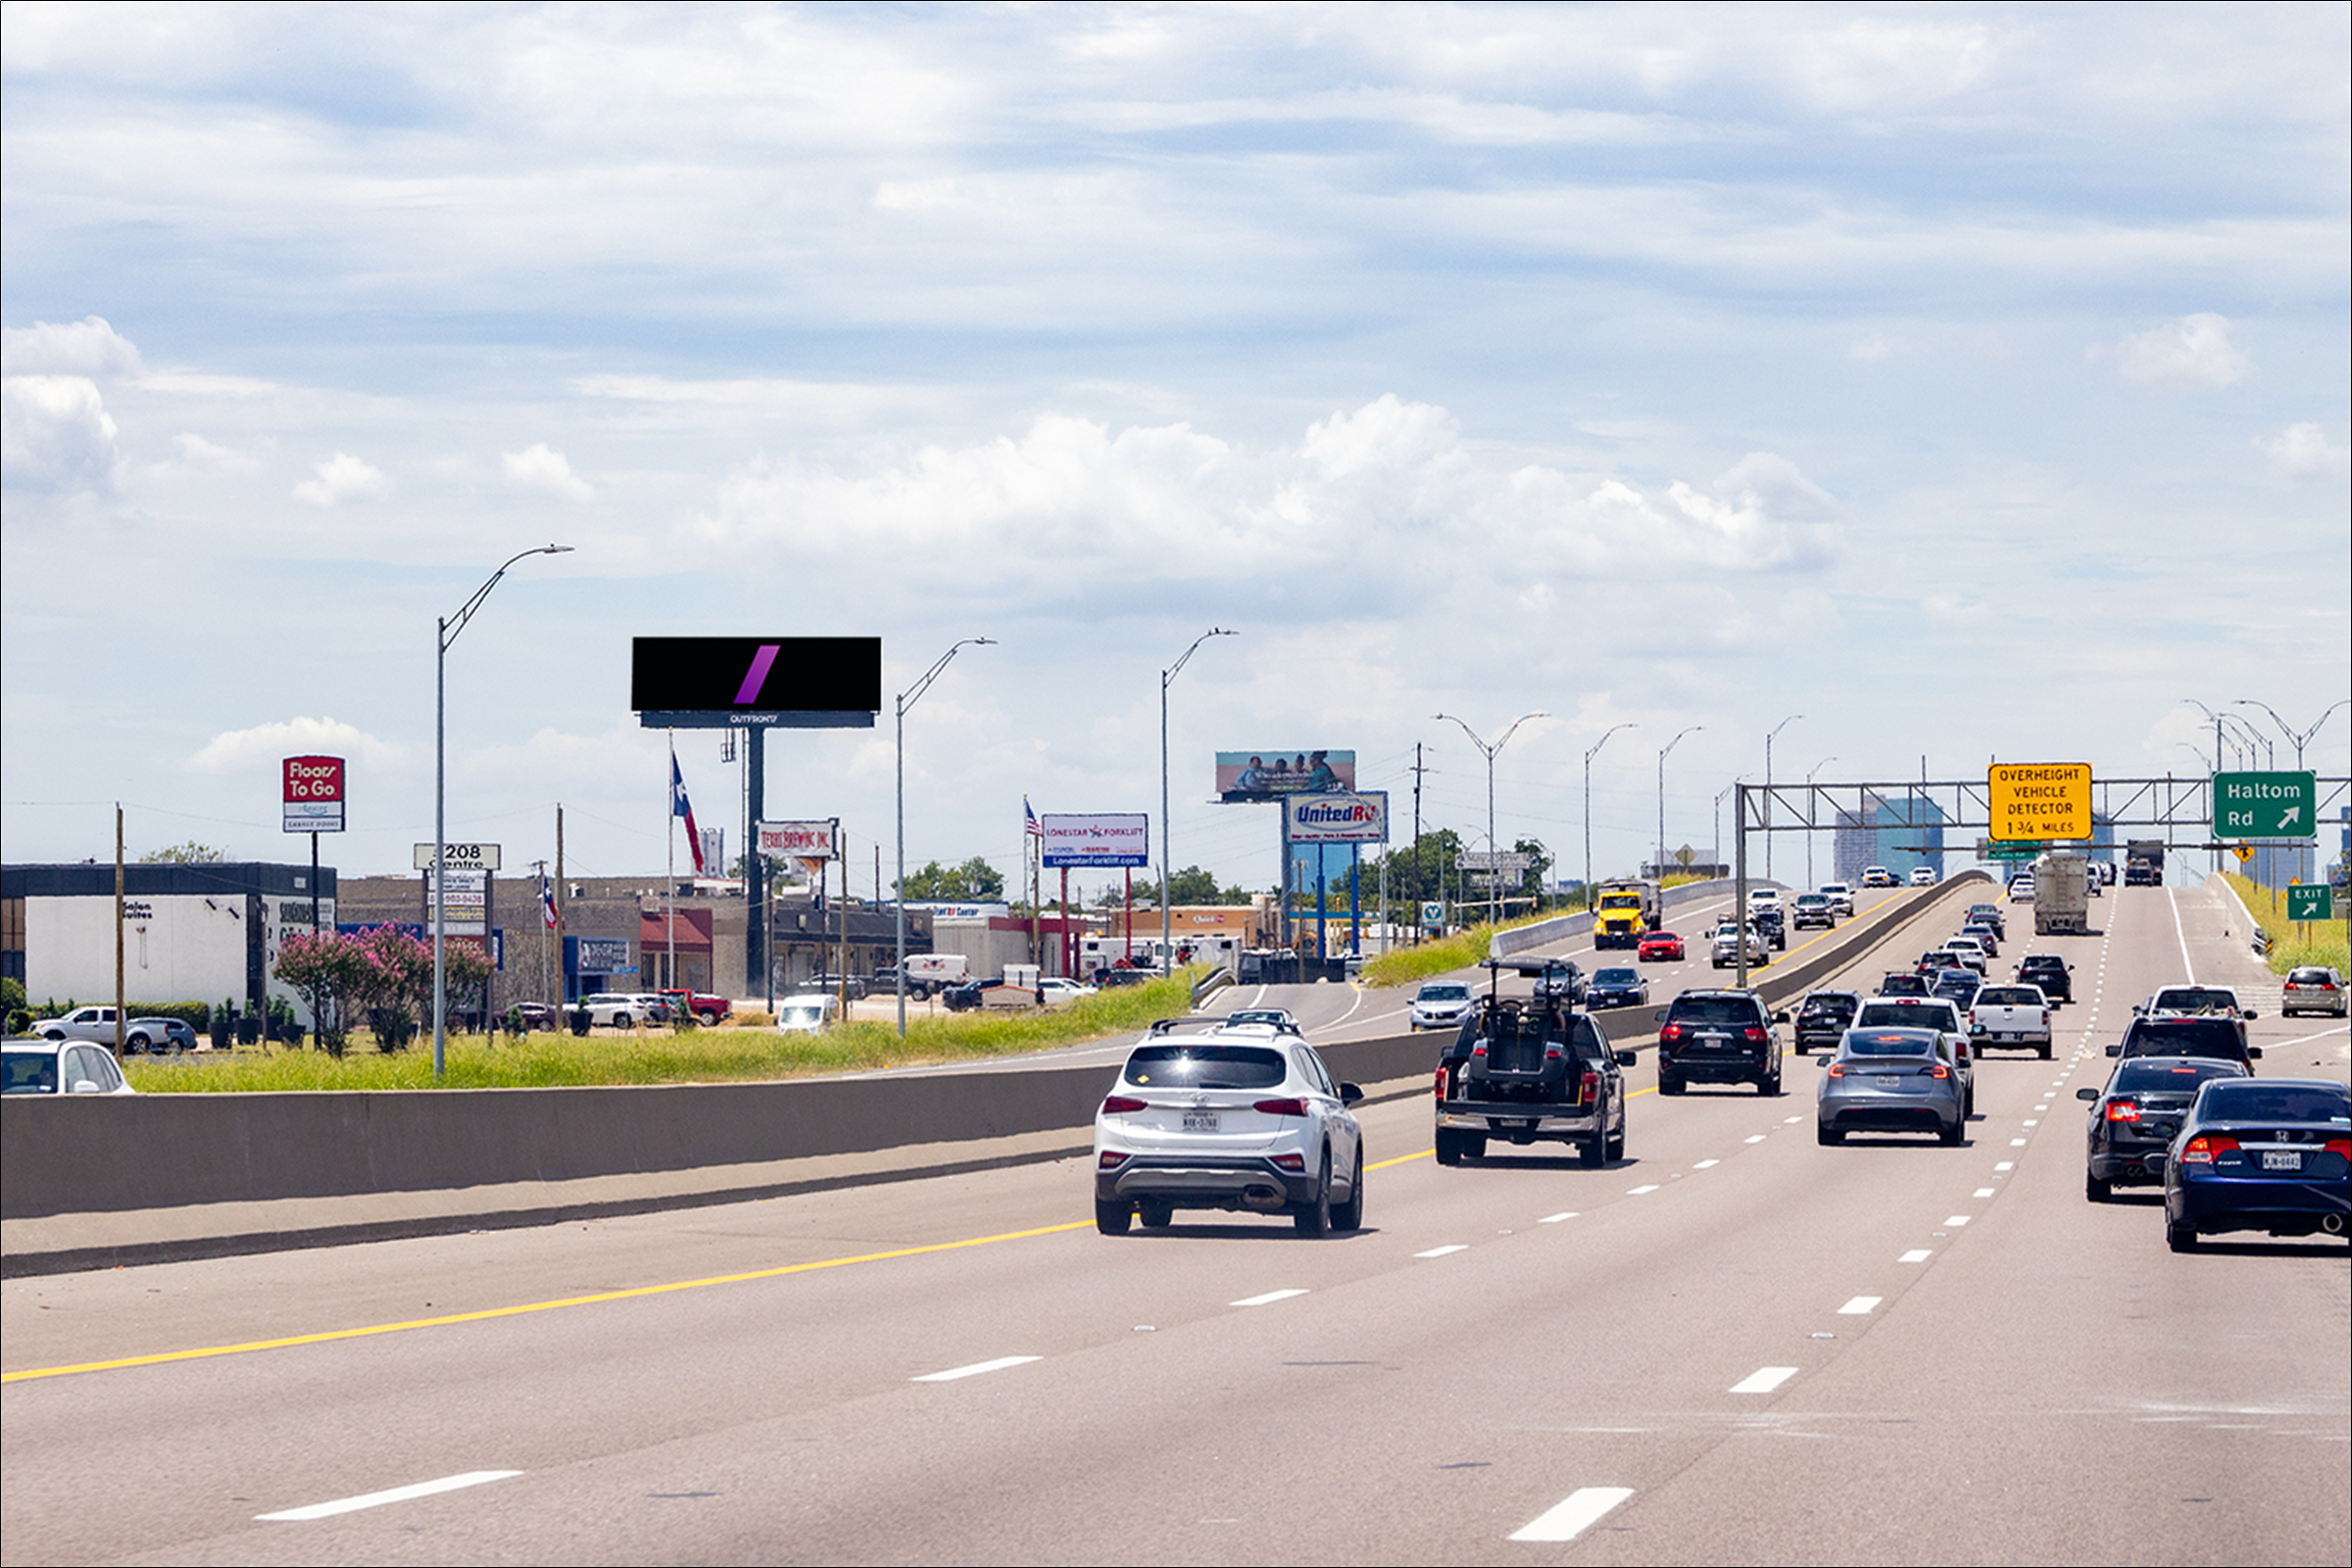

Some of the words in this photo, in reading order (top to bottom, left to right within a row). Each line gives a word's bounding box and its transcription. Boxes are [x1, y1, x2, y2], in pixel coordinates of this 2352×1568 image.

[289, 761, 337, 778] Floors
[1999, 769, 2080, 781] OVERHEIGHT
[289, 780, 309, 797] To
[311, 779, 336, 796] Go
[2013, 786, 2067, 798] VEHICLE
[2228, 783, 2301, 799] Haltom
[2007, 803, 2074, 814] DETECTOR
[2228, 810, 2253, 826] Rd
[1046, 827, 1088, 838] LONESTAR
[1103, 827, 1144, 837] FORKLIFT
[2007, 822, 2013, 834] 1
[2041, 821, 2075, 833] MILES
[2294, 888, 2323, 900] EXIT
